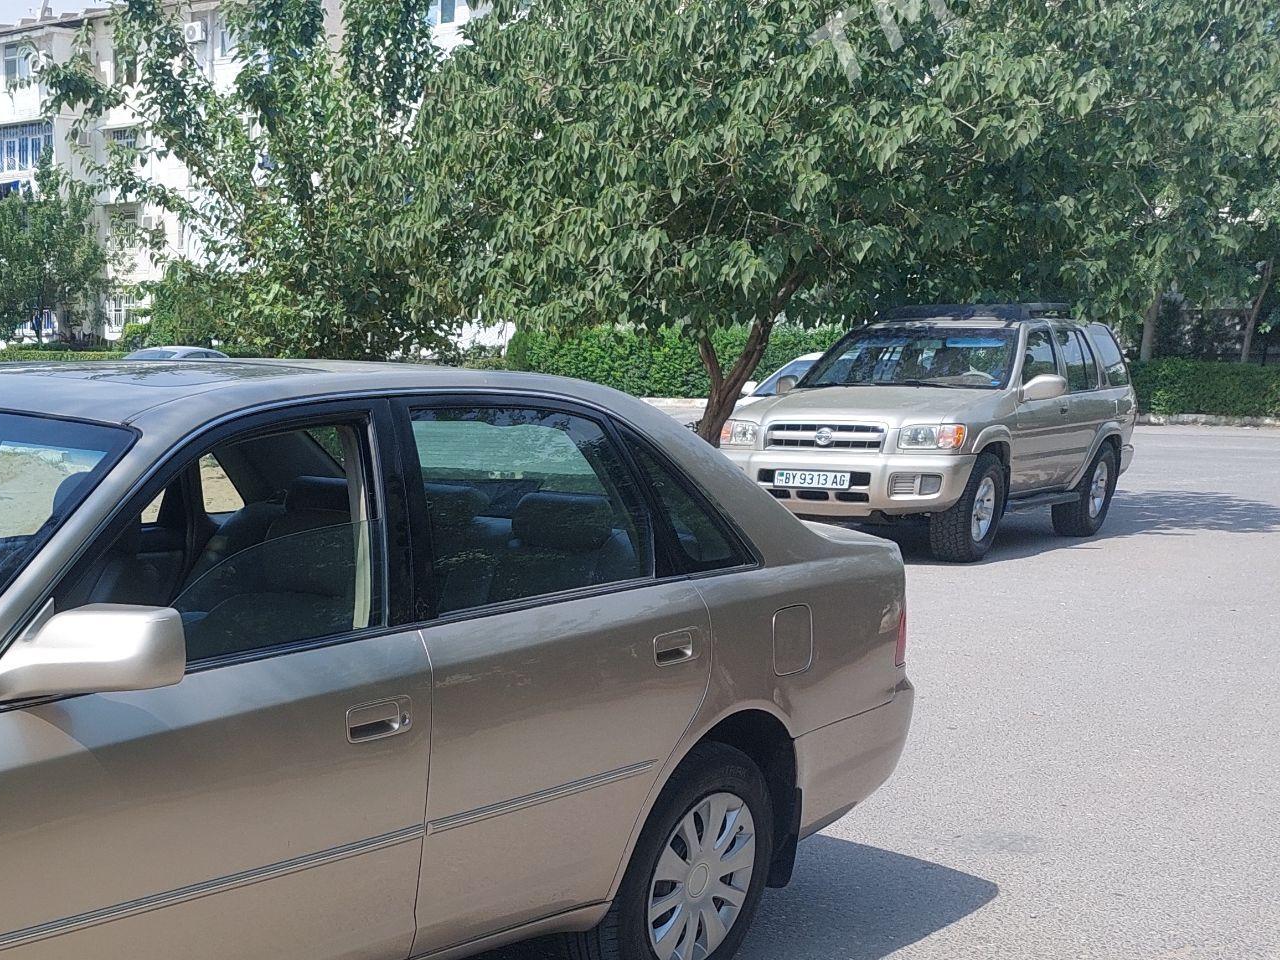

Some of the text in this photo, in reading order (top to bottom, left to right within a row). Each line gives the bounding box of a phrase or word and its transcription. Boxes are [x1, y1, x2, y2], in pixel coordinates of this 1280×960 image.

[785, 472, 798, 484] BY
[800, 473, 829, 486] 9313
[831, 474, 846, 487] AG
